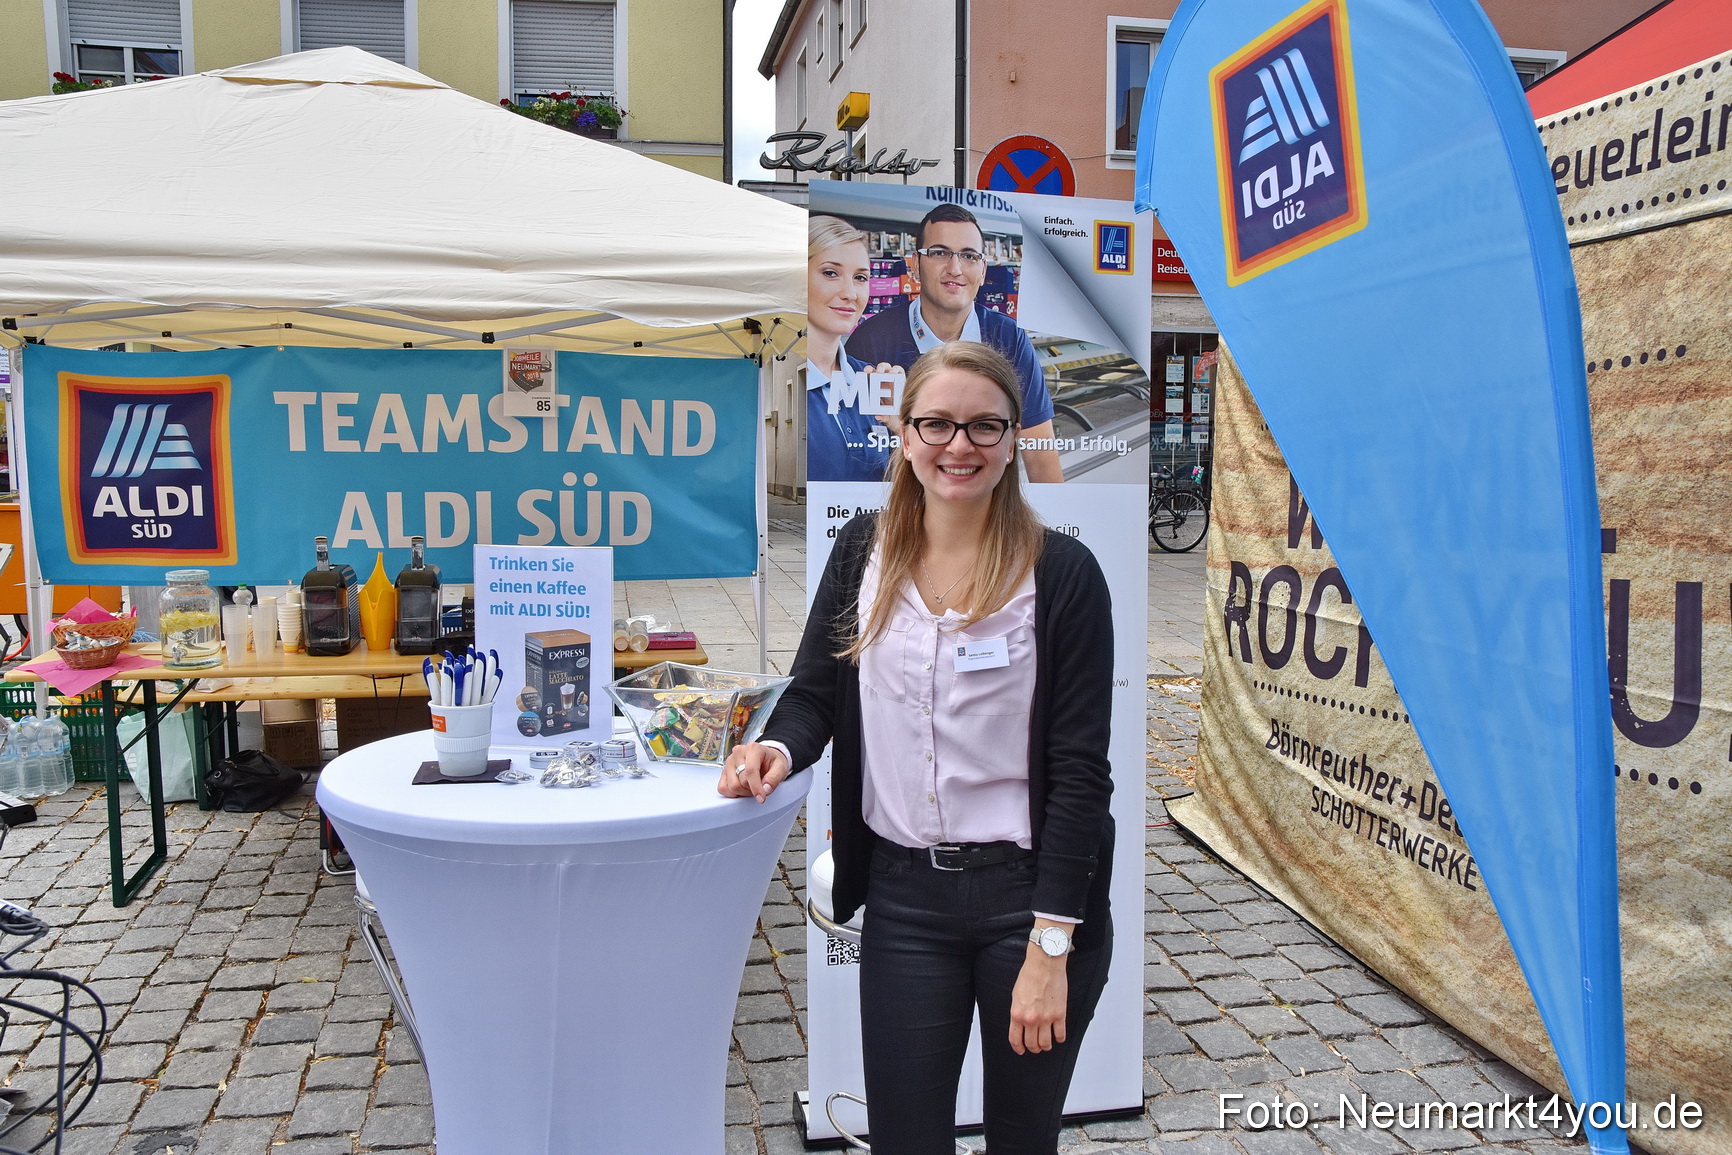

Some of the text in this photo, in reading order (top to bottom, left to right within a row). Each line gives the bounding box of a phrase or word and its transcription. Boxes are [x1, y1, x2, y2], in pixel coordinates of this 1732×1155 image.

[759, 130, 941, 175] Rialto
[1044, 216, 1075, 226] Einfach.
[1044, 227, 1089, 238] Erfolgreich.
[1101, 253, 1126, 264] ALDI
[514, 353, 538, 361] JOBMEILE
[511, 362, 541, 371] NEUMARKT
[536, 400, 551, 412] 85
[273, 391, 716, 457] TEAMSTAND
[1080, 434, 1133, 457] Erfolg.
[92, 485, 204, 518] ALDI
[331, 471, 652, 549] ALDI SÜD
[827, 505, 850, 519] Die
[131, 518, 173, 539] SÜD
[489, 555, 575, 572] Trinken Sie
[489, 577, 587, 595] einen Kaffee
[490, 600, 590, 619] mit ALDI SÜD!
[549, 648, 585, 661] EXPRESSI
[1311, 785, 1478, 892] SCHOTTERWERKE
